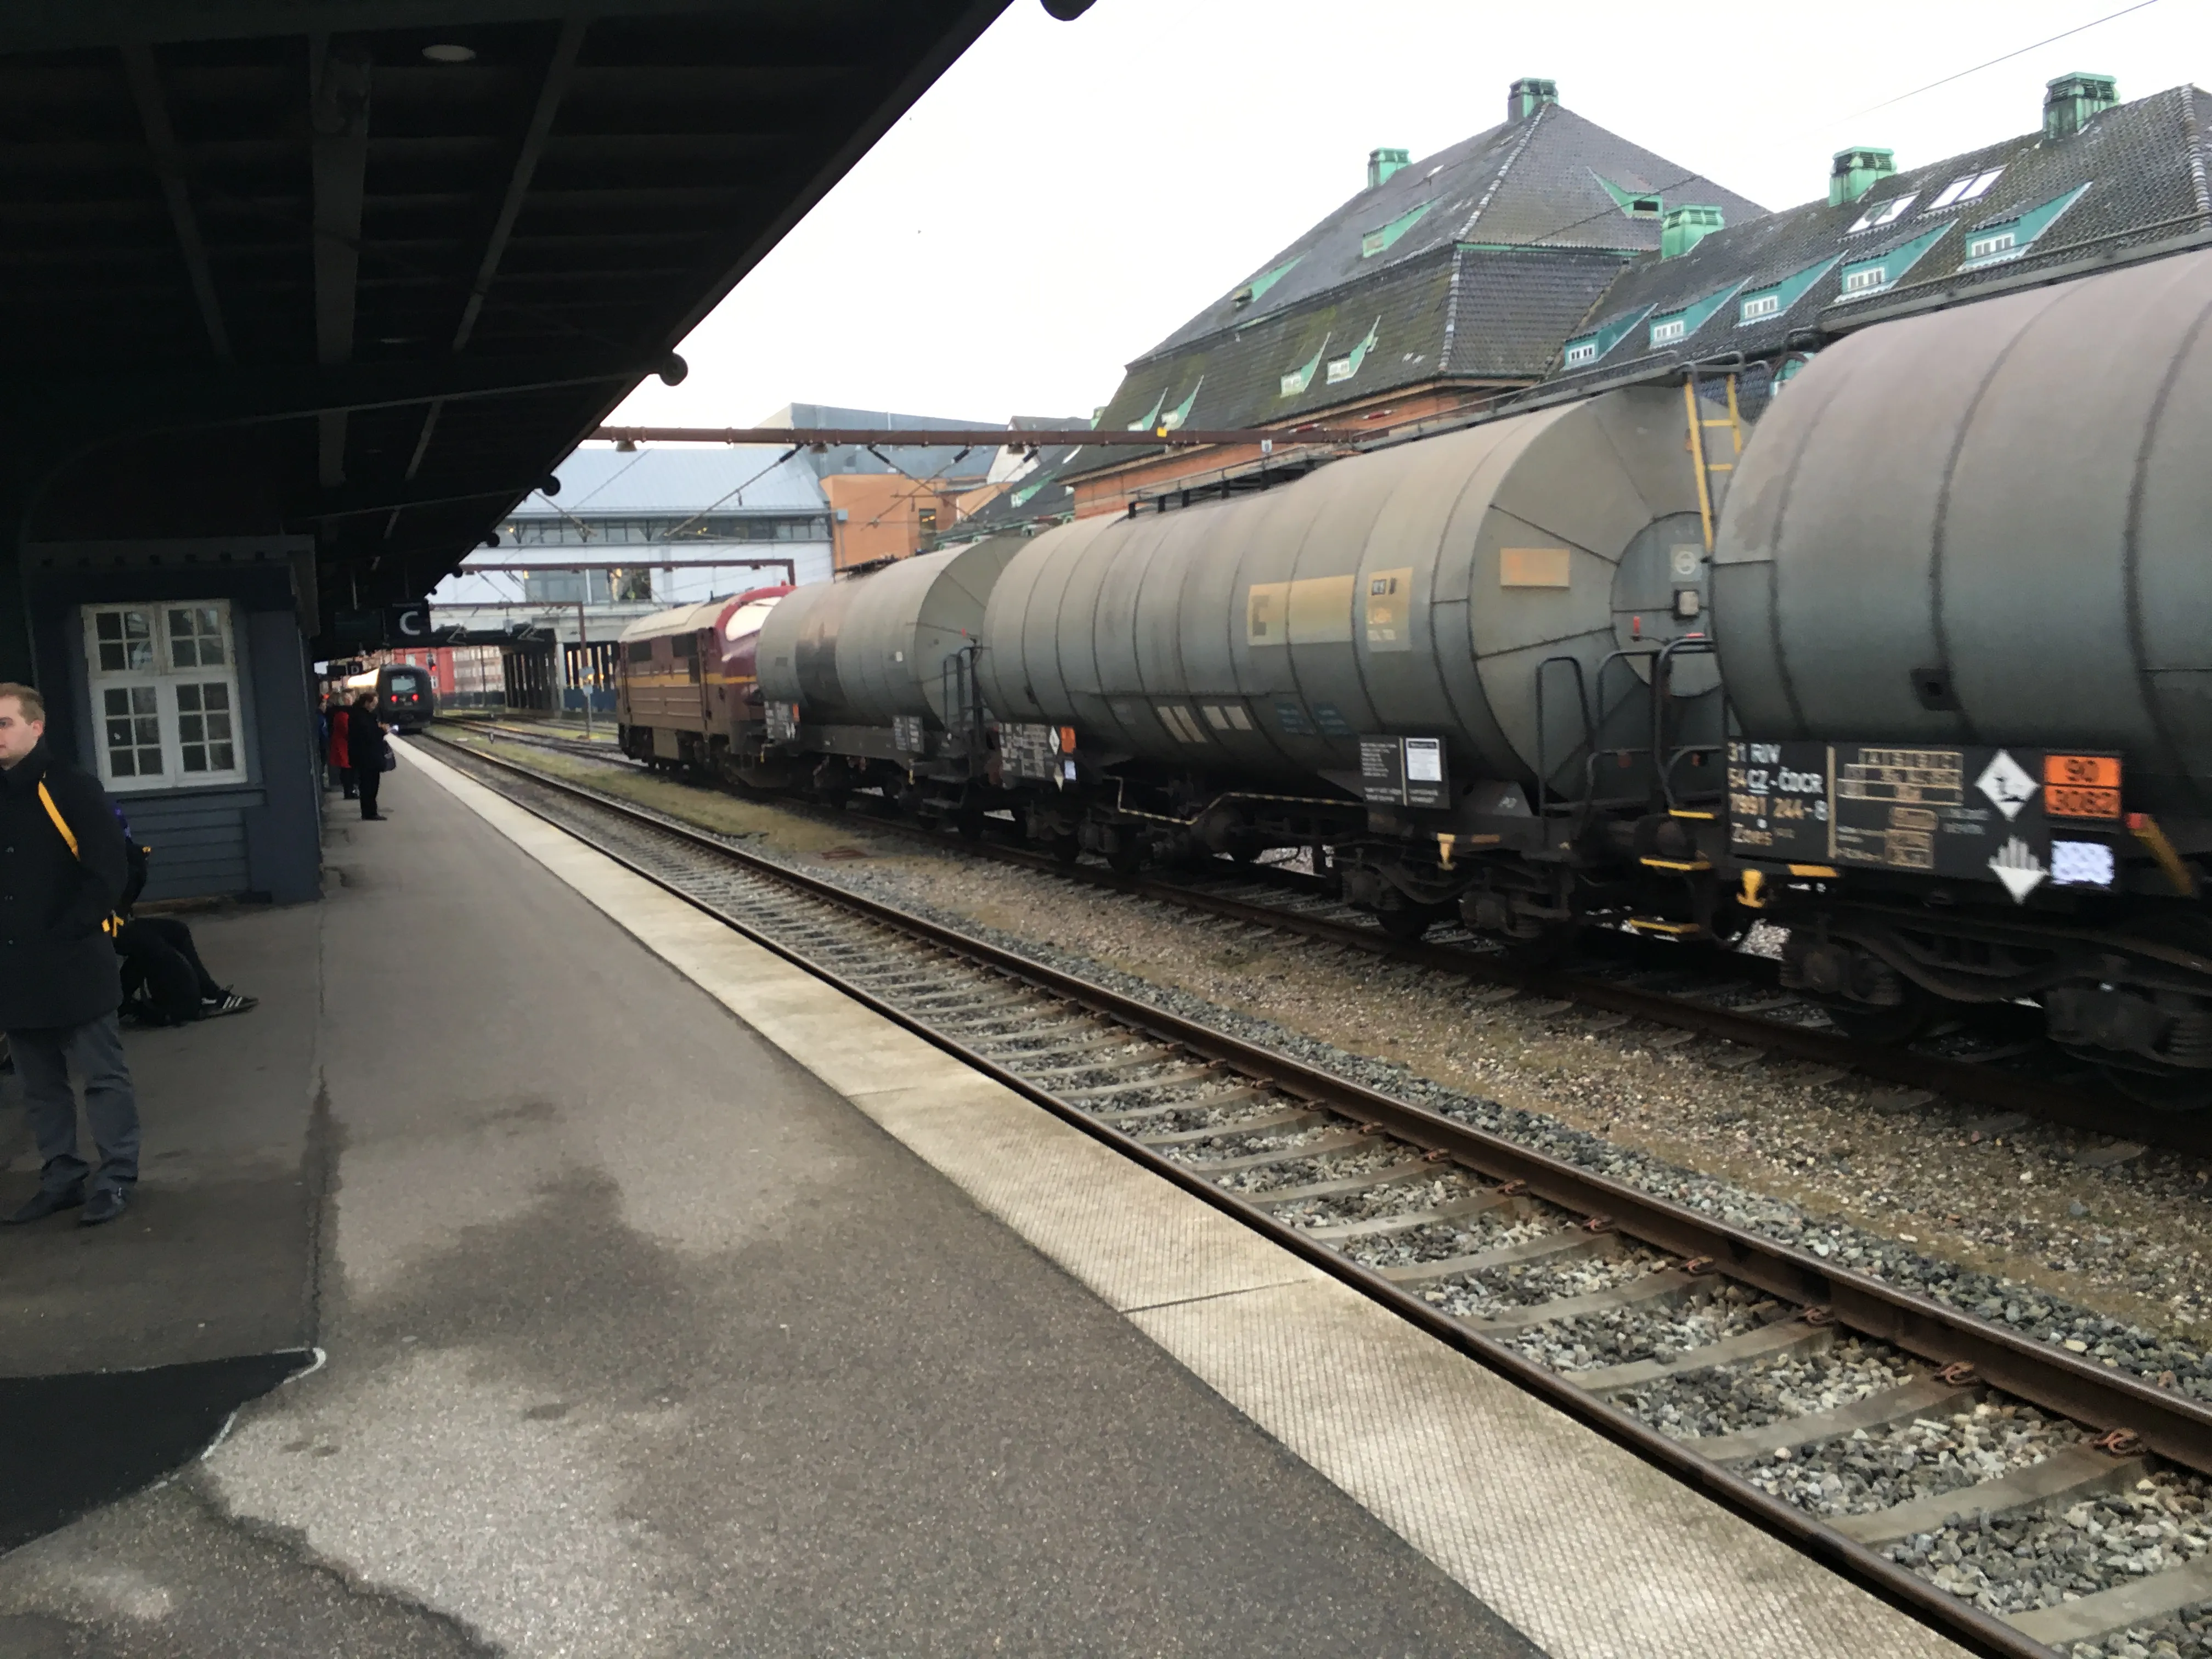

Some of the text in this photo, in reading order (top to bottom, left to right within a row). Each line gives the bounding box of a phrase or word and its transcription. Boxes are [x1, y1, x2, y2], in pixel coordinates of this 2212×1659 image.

[399, 611, 420, 636] C
[351, 665, 360, 675] D
[2064, 759, 2100, 783] 90
